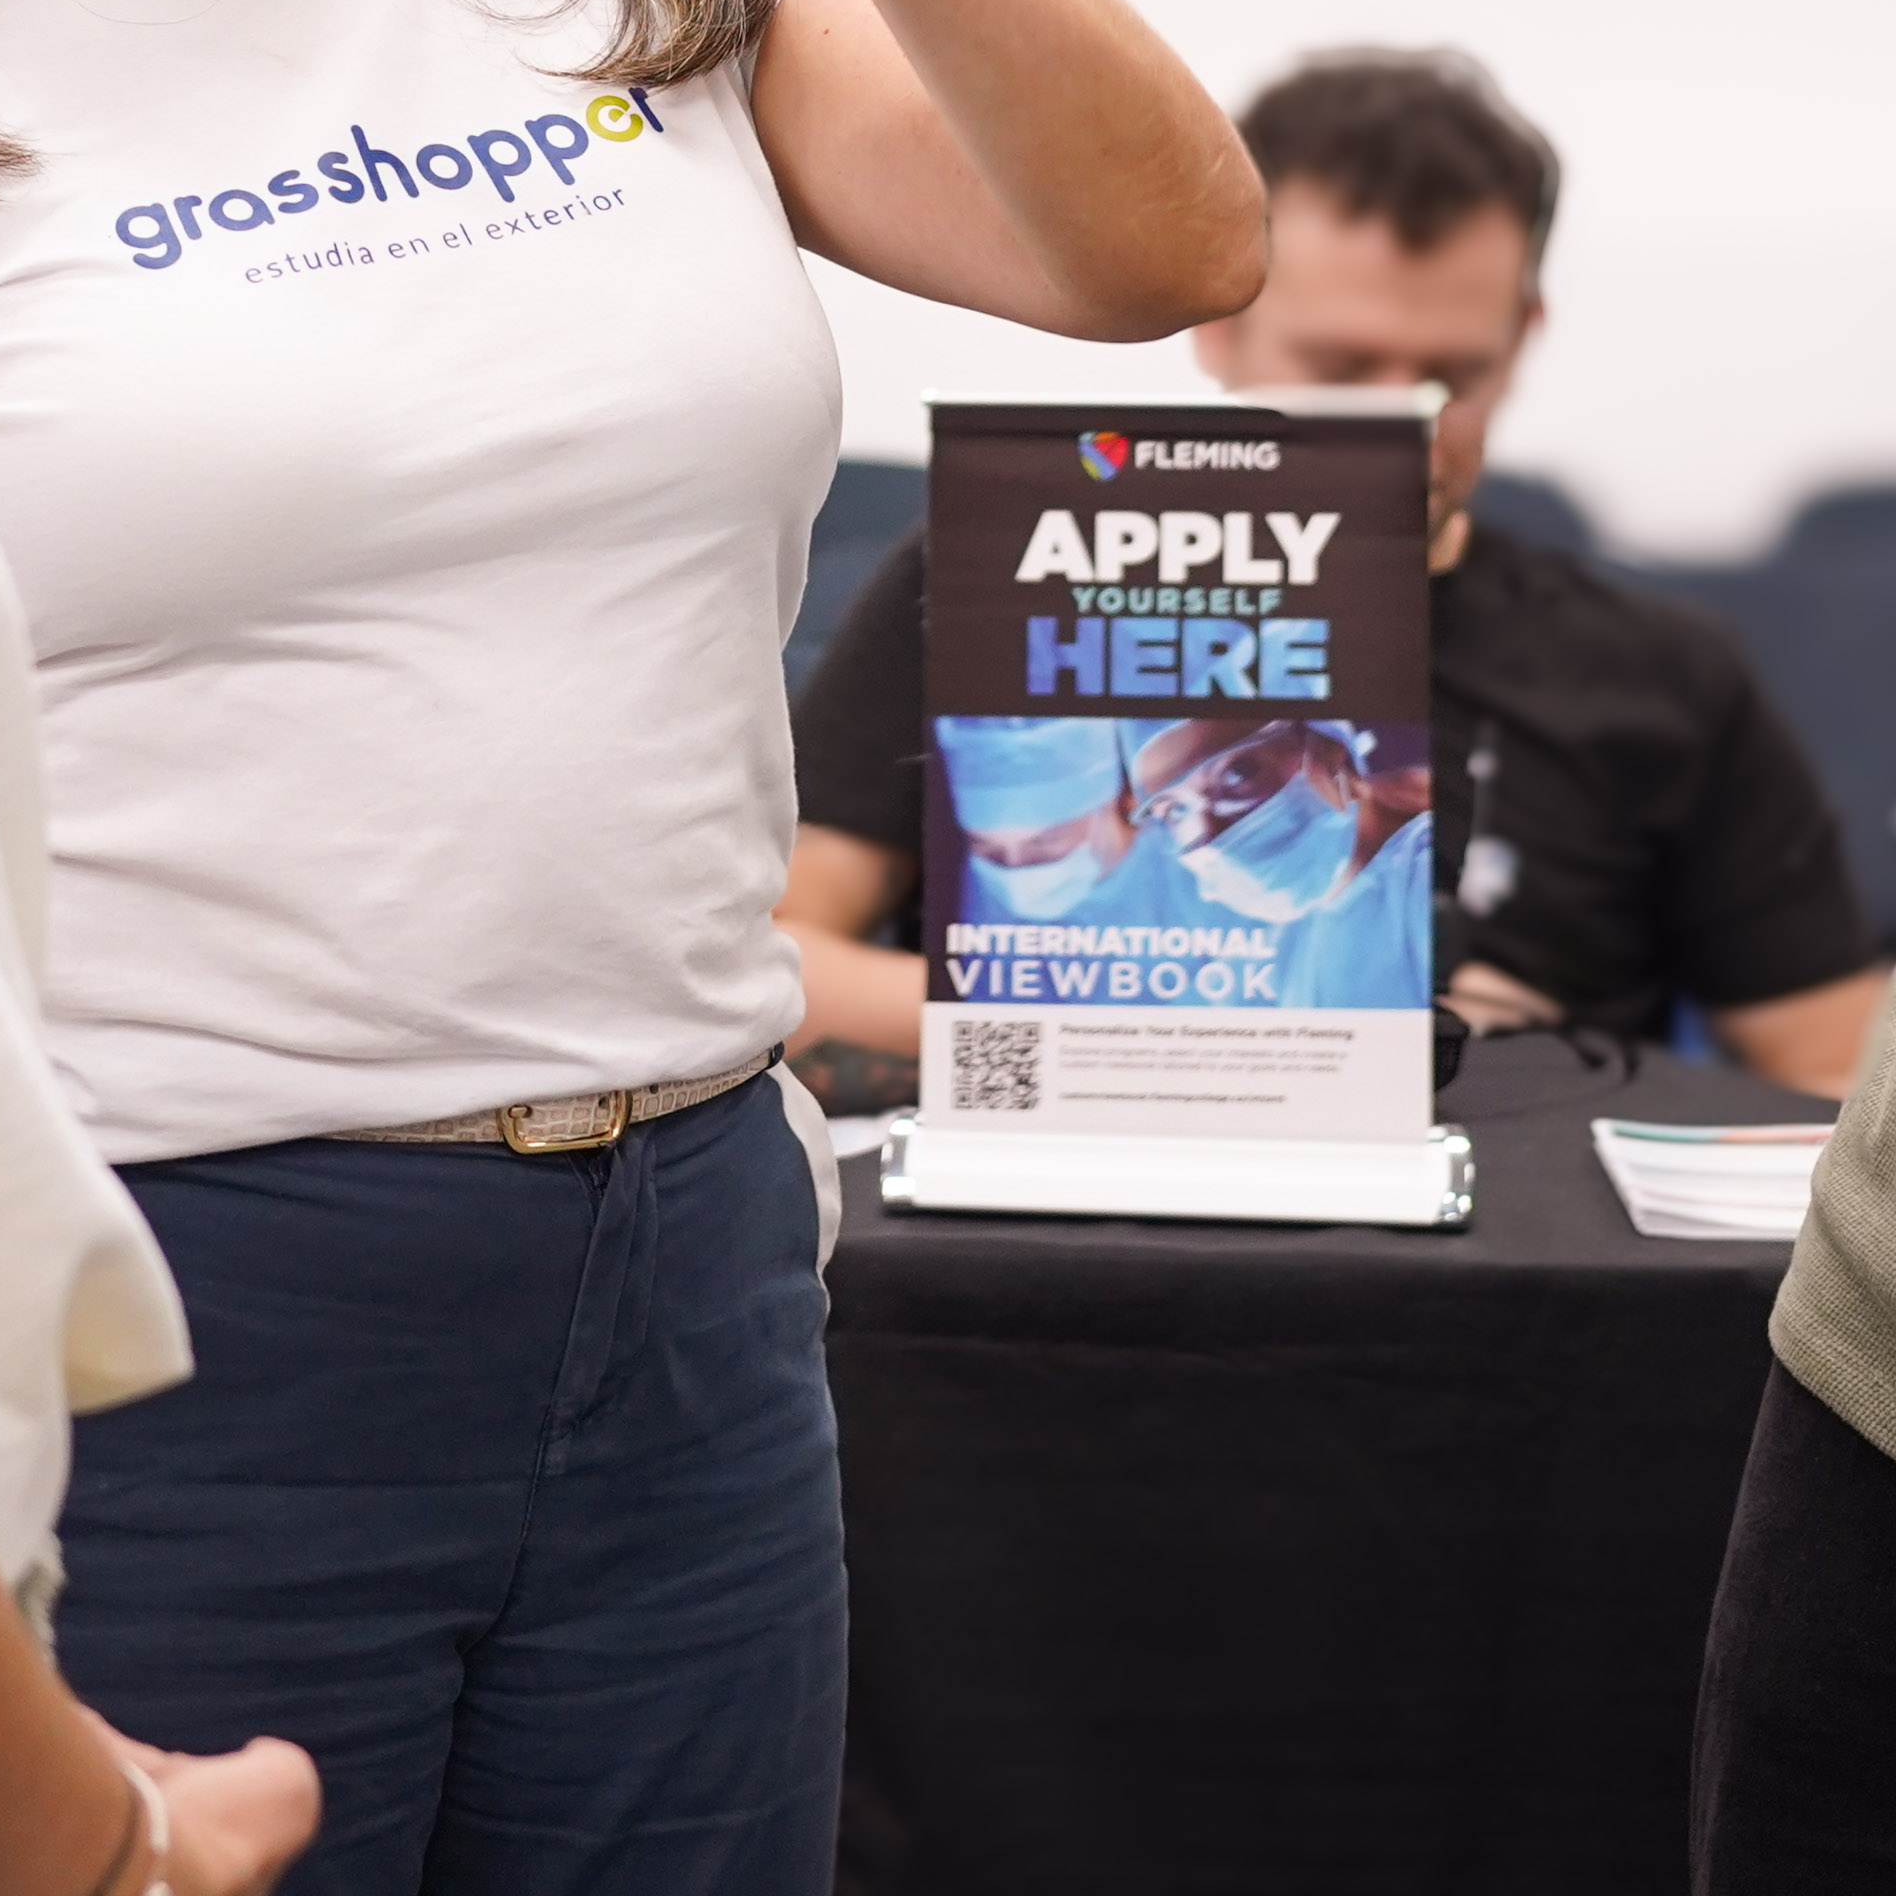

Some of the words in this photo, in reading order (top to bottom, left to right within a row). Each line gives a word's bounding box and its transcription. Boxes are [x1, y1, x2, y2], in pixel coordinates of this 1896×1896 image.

[114, 86, 665, 270] grasshopper
[244, 241, 375, 285] estudia
[387, 236, 431, 260] en
[441, 222, 474, 250] el
[484, 186, 626, 242] exterior
[1134, 440, 1281, 471] FLEMING
[1014, 509, 1341, 585] APPLY
[1072, 585, 1284, 616] YOURSELF
[1026, 615, 1332, 700] HERE
[946, 922, 1278, 960] INTERNATIONAL
[946, 958, 1278, 1001] VIEWBOOK
